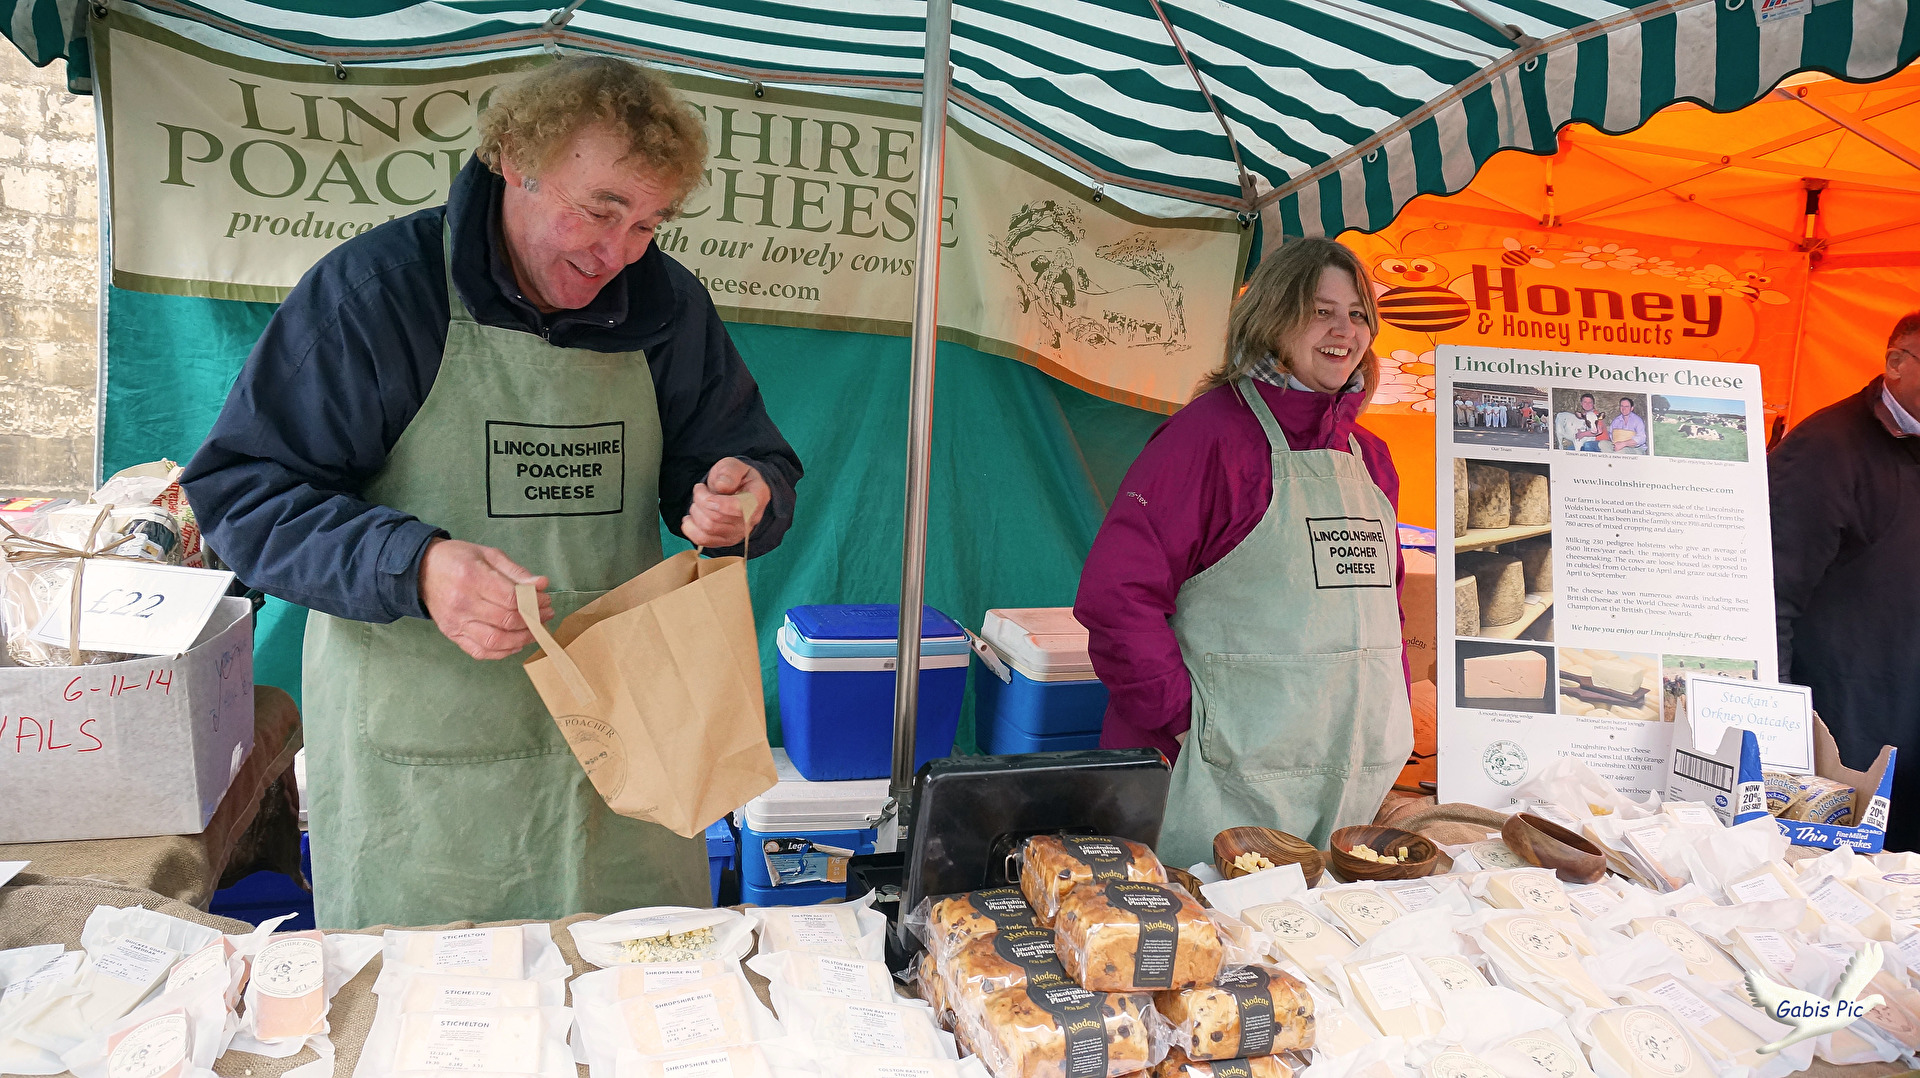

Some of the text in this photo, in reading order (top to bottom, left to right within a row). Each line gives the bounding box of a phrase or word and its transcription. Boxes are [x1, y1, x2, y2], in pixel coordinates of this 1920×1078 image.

[223, 211, 396, 240] produce
[653, 225, 689, 253] ith
[700, 237, 753, 259] our
[761, 236, 843, 275] lovely
[1472, 264, 1723, 338] Honey
[1477, 312, 1673, 346] & Honey Products
[1453, 355, 1744, 390] Lincolnshire Poacher Cheese
[493, 439, 621, 457] LINCOLNSHIRE
[516, 463, 603, 478] POACHER
[524, 485, 595, 500] CHEESE
[1705, 505, 1744, 513] Lincolnshire
[1313, 530, 1384, 542] LINCOLNSHIRE
[1623, 524, 1652, 533] cropping
[1666, 527, 1684, 535] dairy
[1565, 536, 1590, 545] Milking
[1606, 539, 1634, 548] pedigree
[1637, 541, 1665, 549] holsteins
[1685, 544, 1698, 552] give
[1329, 546, 1378, 557] POACHER
[1336, 562, 1376, 574] CHEESE
[84, 587, 165, 620] £22
[1566, 602, 1600, 612] Champion
[1656, 600, 1679, 608] Cheese
[1583, 624, 1600, 633] hope
[1649, 629, 1692, 638] Lincolnshire
[1692, 632, 1721, 640] Poacher
[1406, 636, 1427, 650] odens
[1720, 691, 1778, 709] Stockan's
[1701, 707, 1801, 731] Orkney Oatcakes
[565, 718, 615, 739] POACHER
[1571, 743, 1606, 751] Lincolnshire
[1745, 784, 1760, 793] NOW
[1743, 792, 1761, 804] 20%
[1873, 799, 1887, 808] NOW
[1740, 804, 1751, 812] LESS
[1870, 806, 1885, 821] 20%
[1795, 826, 1828, 843] Thin
[1836, 831, 1868, 840] Fine Milled
[1098, 869, 1125, 880] Modens
[1115, 884, 1160, 893] Modens
[1144, 919, 1175, 933] Modens
[1003, 929, 1048, 942] Modens
[1015, 950, 1036, 958] Plum
[821, 958, 843, 967] COLSTON
[1031, 970, 1061, 985] Modens
[654, 996, 696, 1009] SHROPSHIRE
[1049, 995, 1072, 1004] Plum
[1241, 994, 1269, 1009] Modens
[440, 1020, 490, 1028] STICHELTON
[1068, 1018, 1101, 1034] Modens
[665, 1057, 728, 1072] SHROPSHIRE BLUE
[1218, 1064, 1248, 1078] Modens
